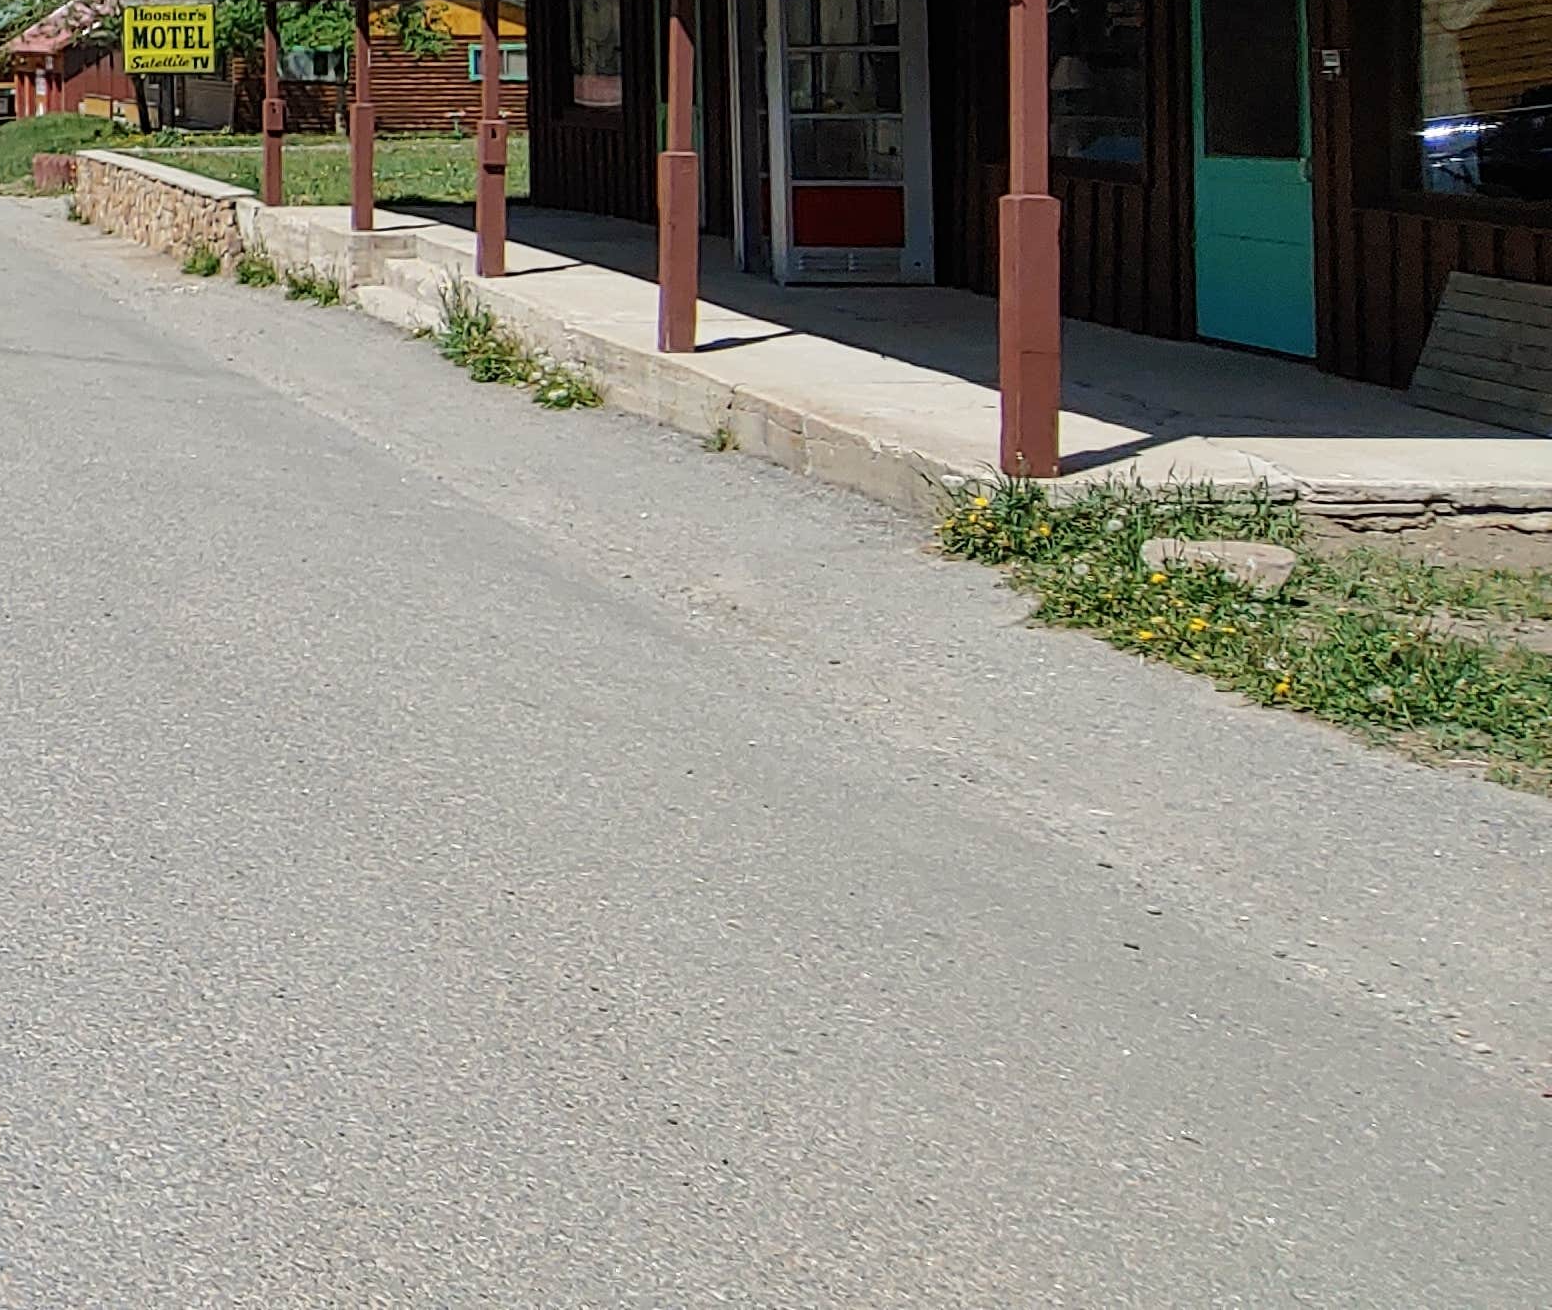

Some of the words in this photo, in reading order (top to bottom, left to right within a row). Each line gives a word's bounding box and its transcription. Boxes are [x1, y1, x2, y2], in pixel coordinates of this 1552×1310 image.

[133, 8, 207, 21] Hoosier's
[132, 26, 210, 49] MOTEL
[131, 54, 189, 69] Satellite
[192, 56, 209, 69] TV
